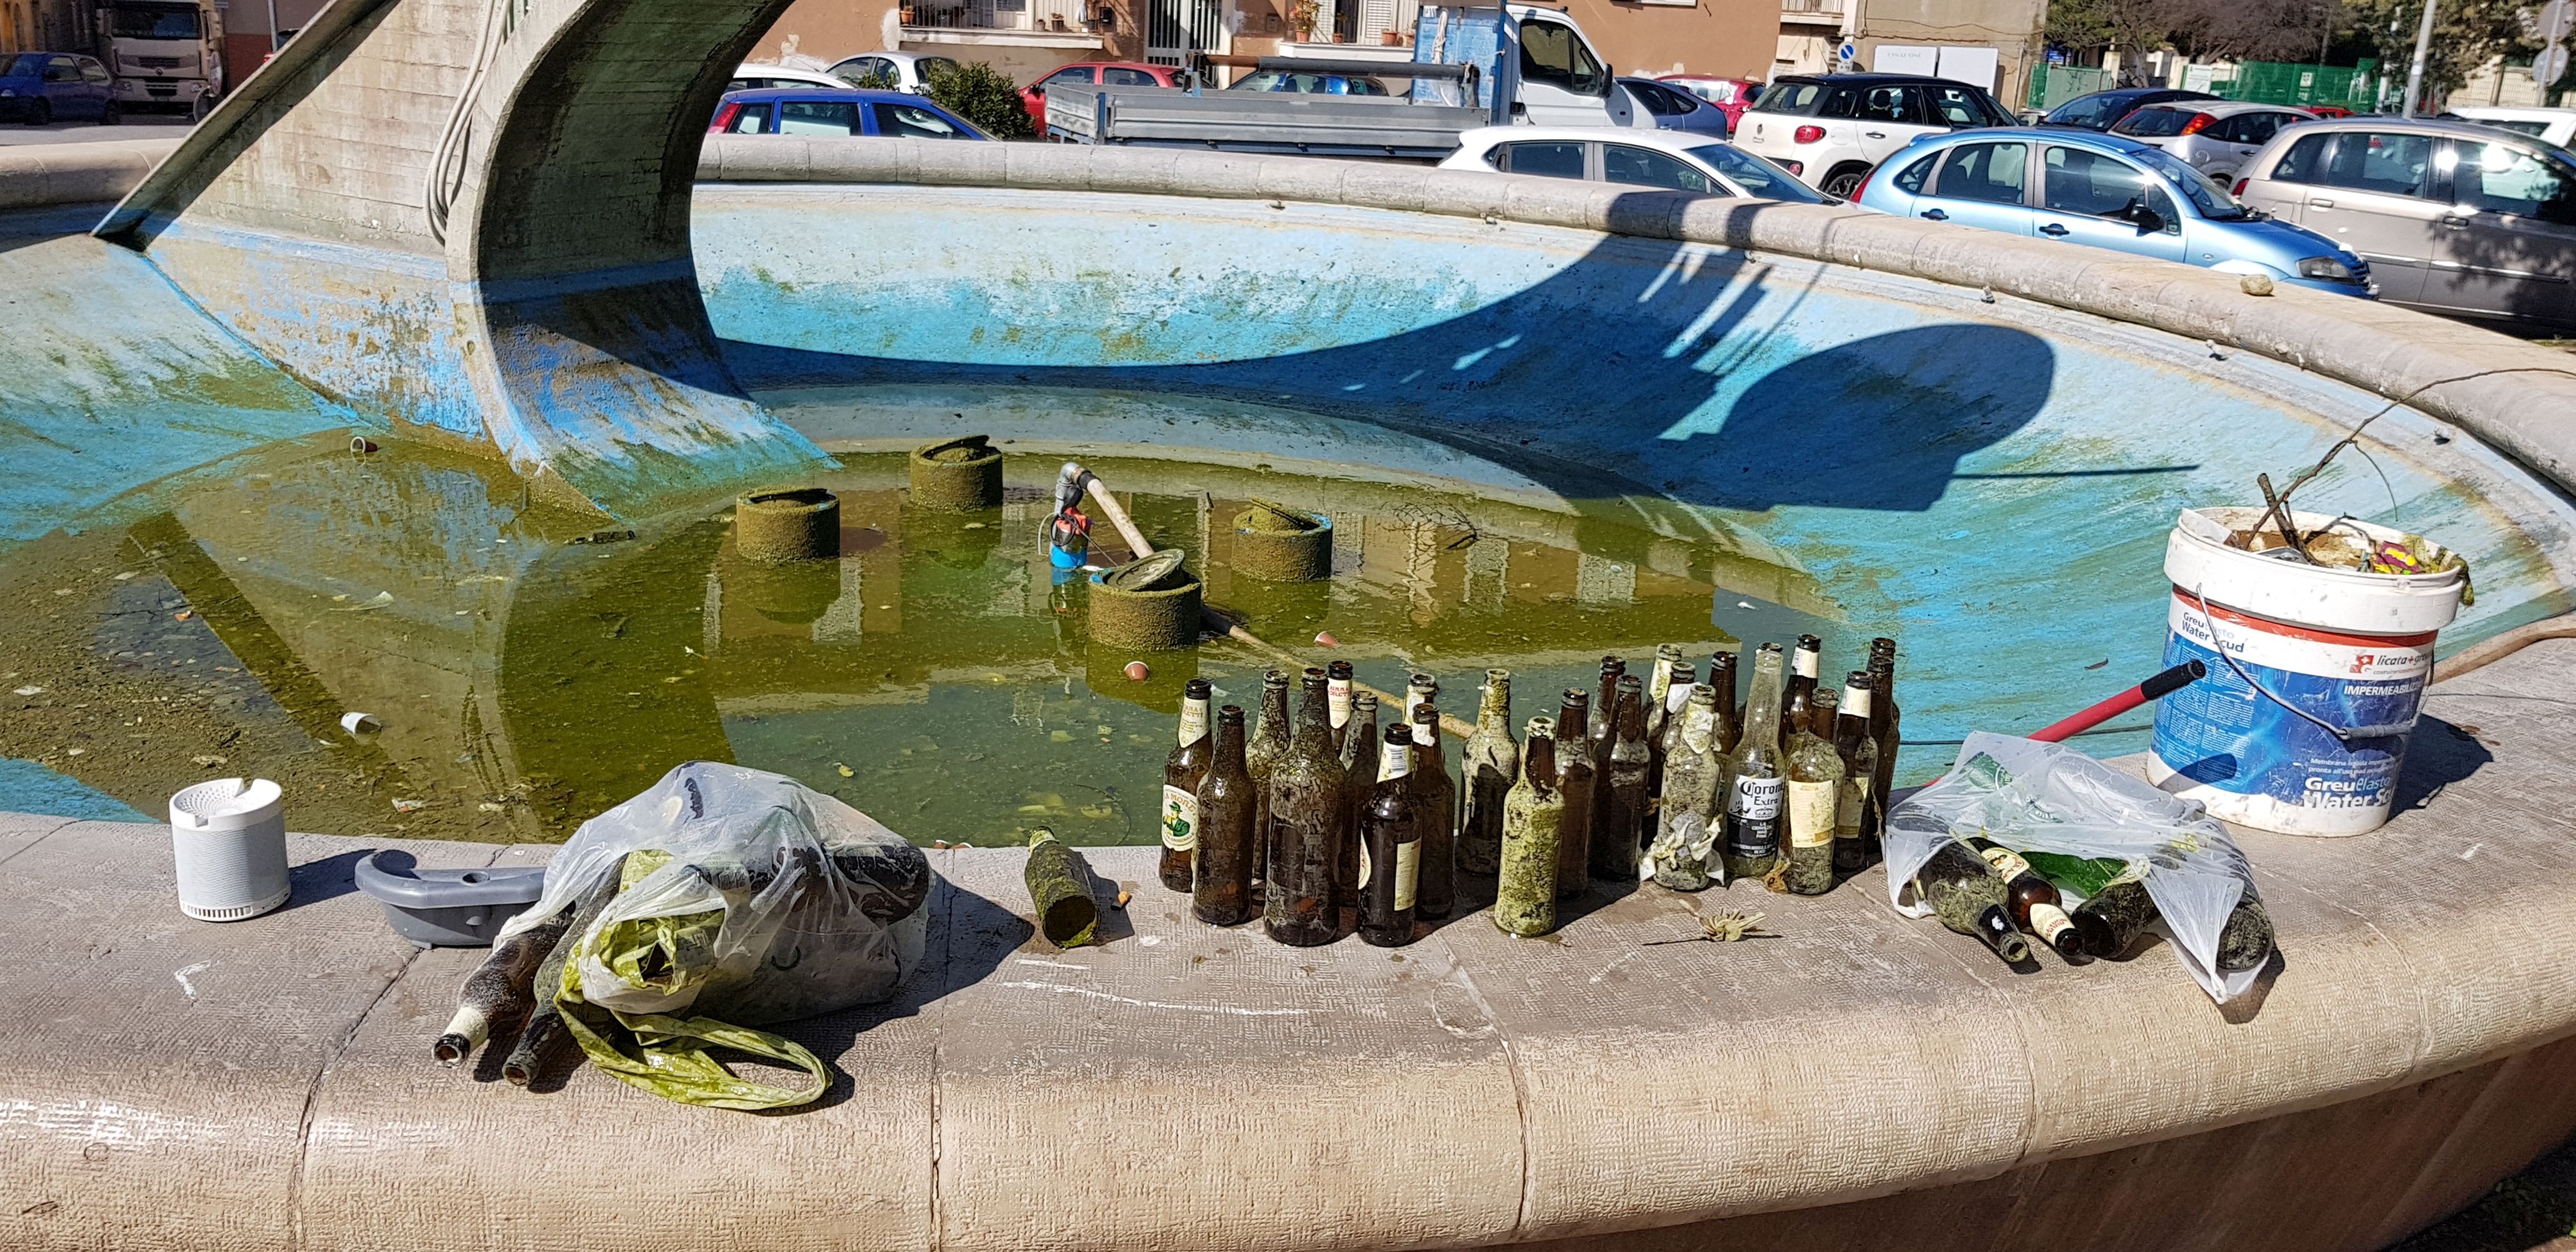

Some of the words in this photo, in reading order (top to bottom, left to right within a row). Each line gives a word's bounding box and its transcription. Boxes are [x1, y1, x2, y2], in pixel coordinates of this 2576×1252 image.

[2182, 620, 2210, 640] Water
[2310, 758, 2347, 766] Membrana
[2305, 776, 2393, 792] Greuelasto
[1754, 796, 1778, 806] Extra
[2303, 790, 2373, 809] Water
